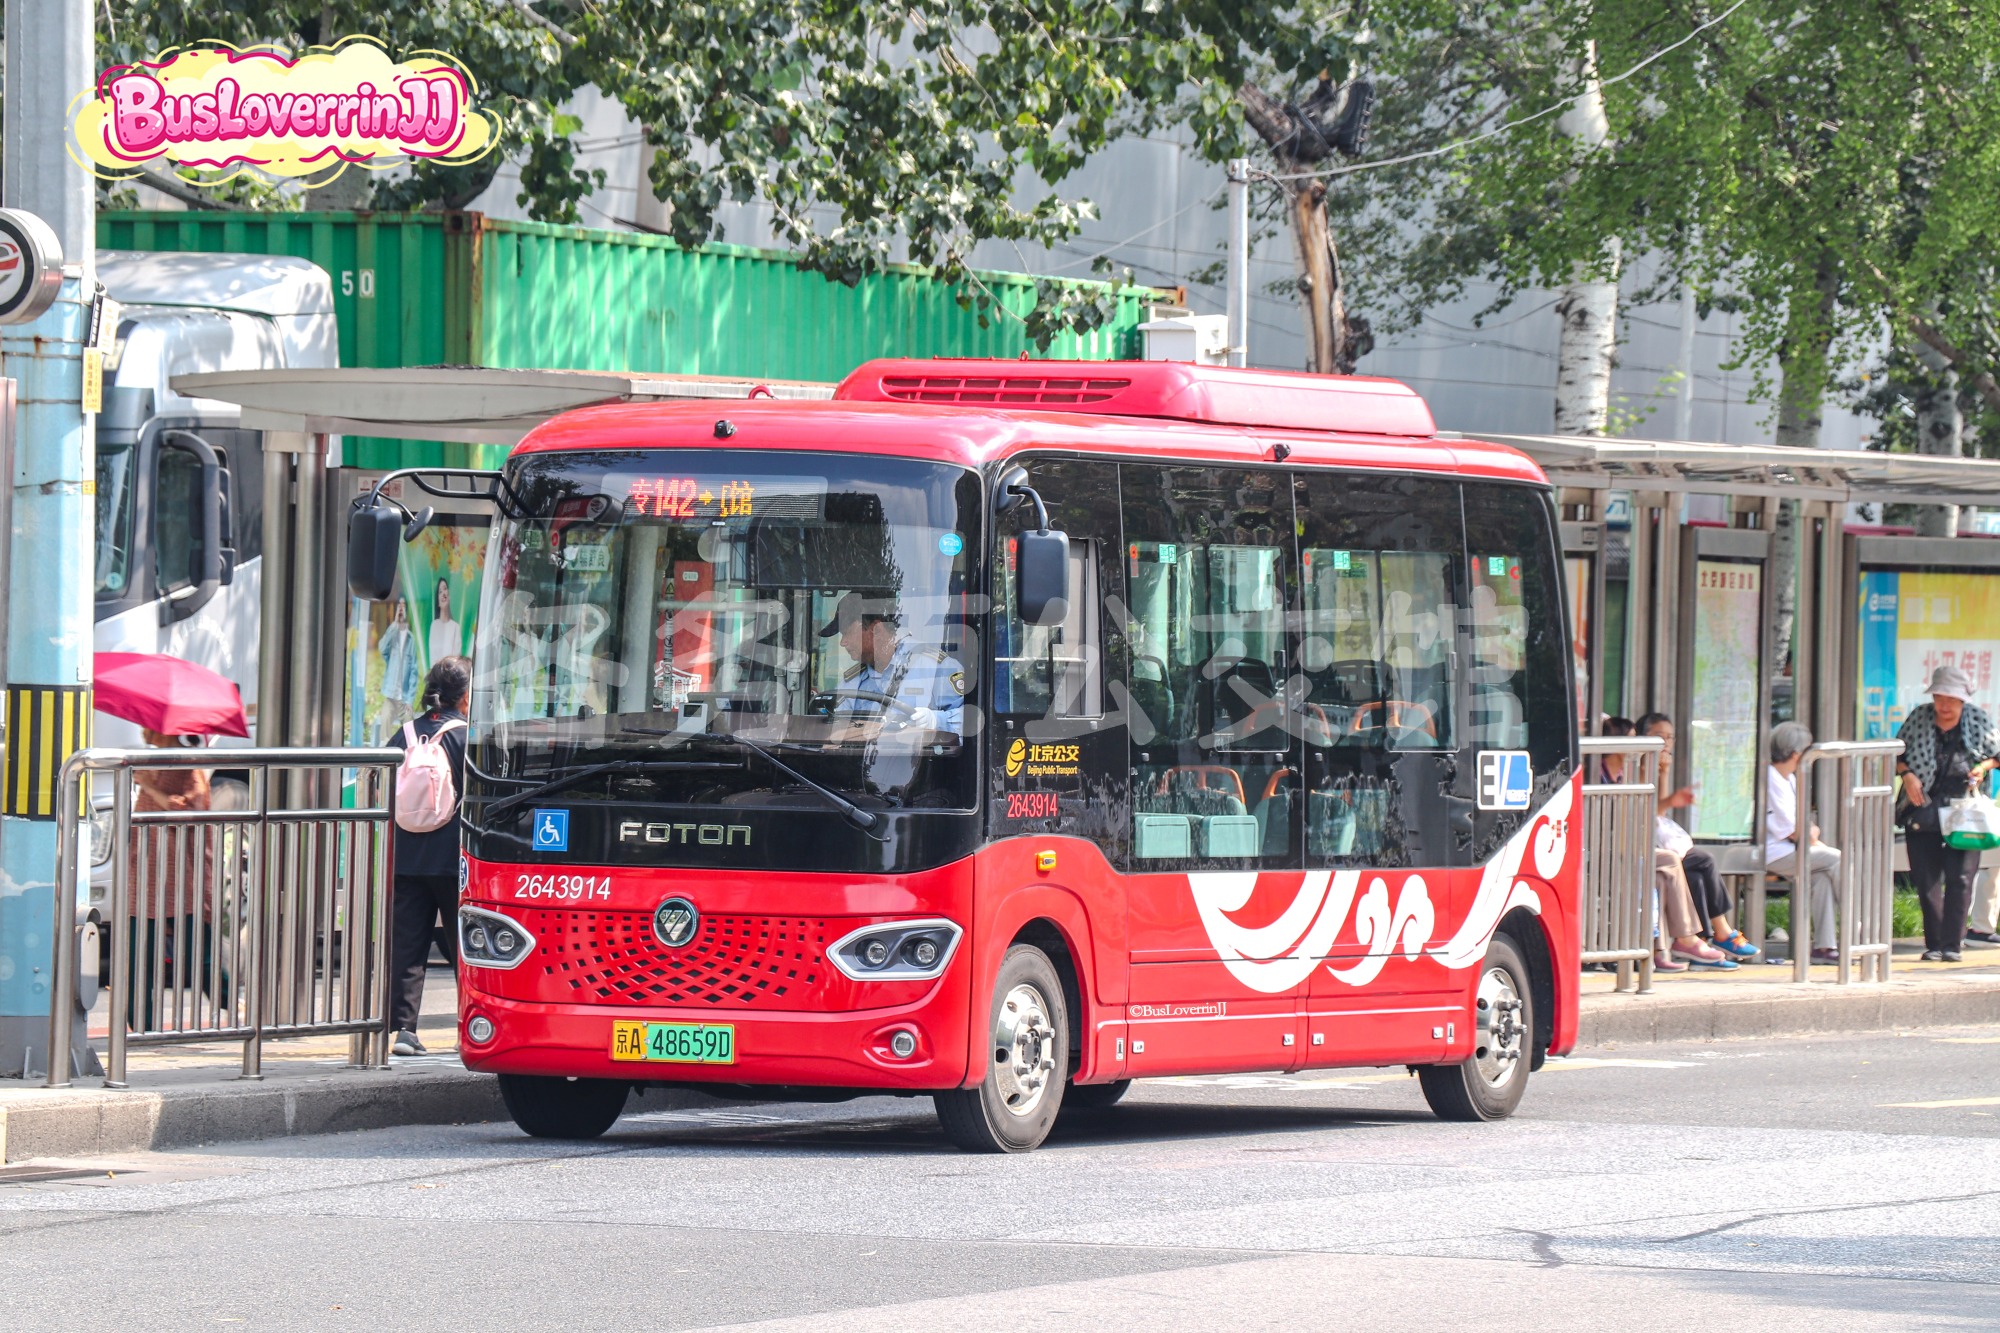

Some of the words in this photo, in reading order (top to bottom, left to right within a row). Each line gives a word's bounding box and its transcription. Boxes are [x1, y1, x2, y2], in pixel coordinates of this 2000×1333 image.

[1027, 745, 1080, 762] 北京公交
[1027, 765, 1043, 776] Beijing
[1042, 765, 1056, 775] Public
[1056, 765, 1078, 776] Transport
[1007, 793, 1058, 818] 2643914
[619, 821, 751, 846] FOTON
[514, 874, 611, 900] 2643914
[652, 1028, 731, 1058] 48659D
